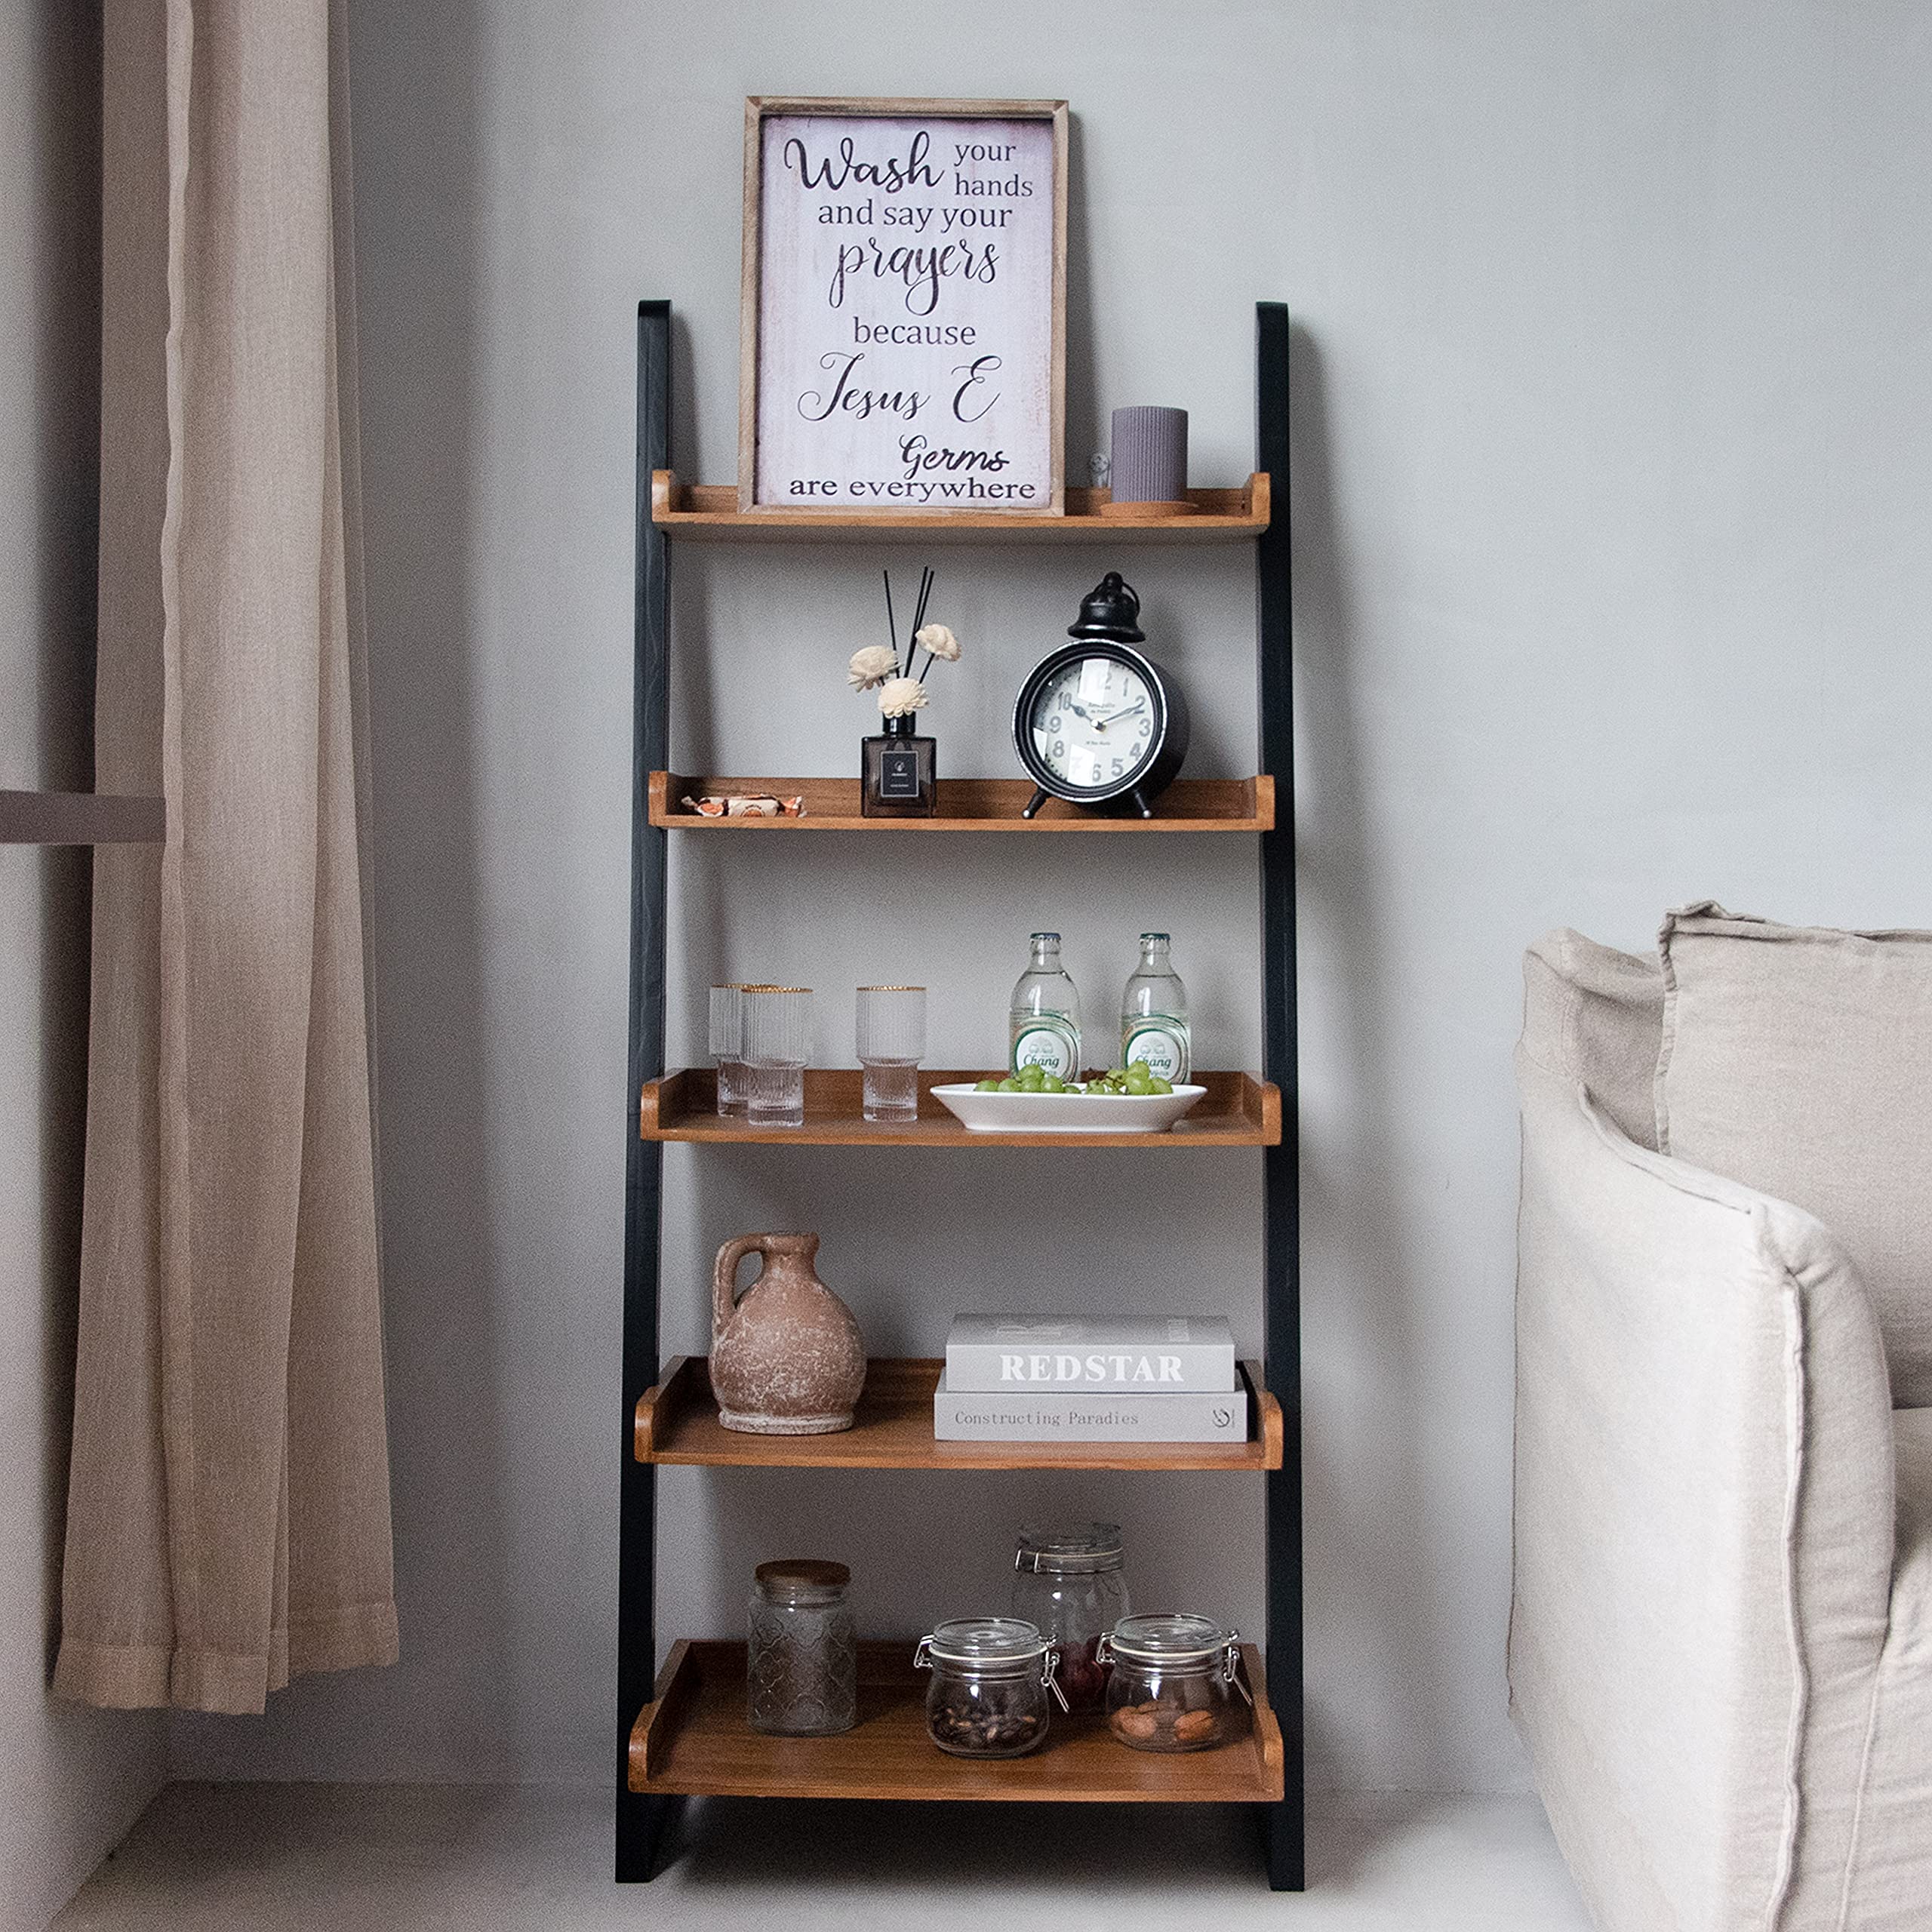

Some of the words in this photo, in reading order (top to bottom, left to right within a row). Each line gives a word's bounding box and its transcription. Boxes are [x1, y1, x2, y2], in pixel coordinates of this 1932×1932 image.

[783, 131, 944, 193] Wash
[954, 143, 1017, 167] your
[955, 173, 1033, 198] hands
[818, 198, 873, 225] and
[883, 205, 934, 233] say
[940, 208, 1013, 233] your
[829, 237, 1000, 317] prayers
[853, 316, 977, 346] because
[797, 352, 931, 422] Jesus
[898, 435, 1010, 480] Germs
[789, 478, 838, 497] are
[849, 477, 1036, 503] everywhere
[1050, 716, 1061, 734] 9
[1139, 718, 1151, 737] 3
[1053, 740, 1065, 758] 8
[1130, 743, 1142, 761] 4
[1111, 758, 1124, 777] 5
[1023, 1054, 1060, 1069] Chang
[998, 1355, 1184, 1383] REDSTAR
[955, 1411, 1060, 1426] Constructing
[1068, 1412, 1140, 1426] Paradies
